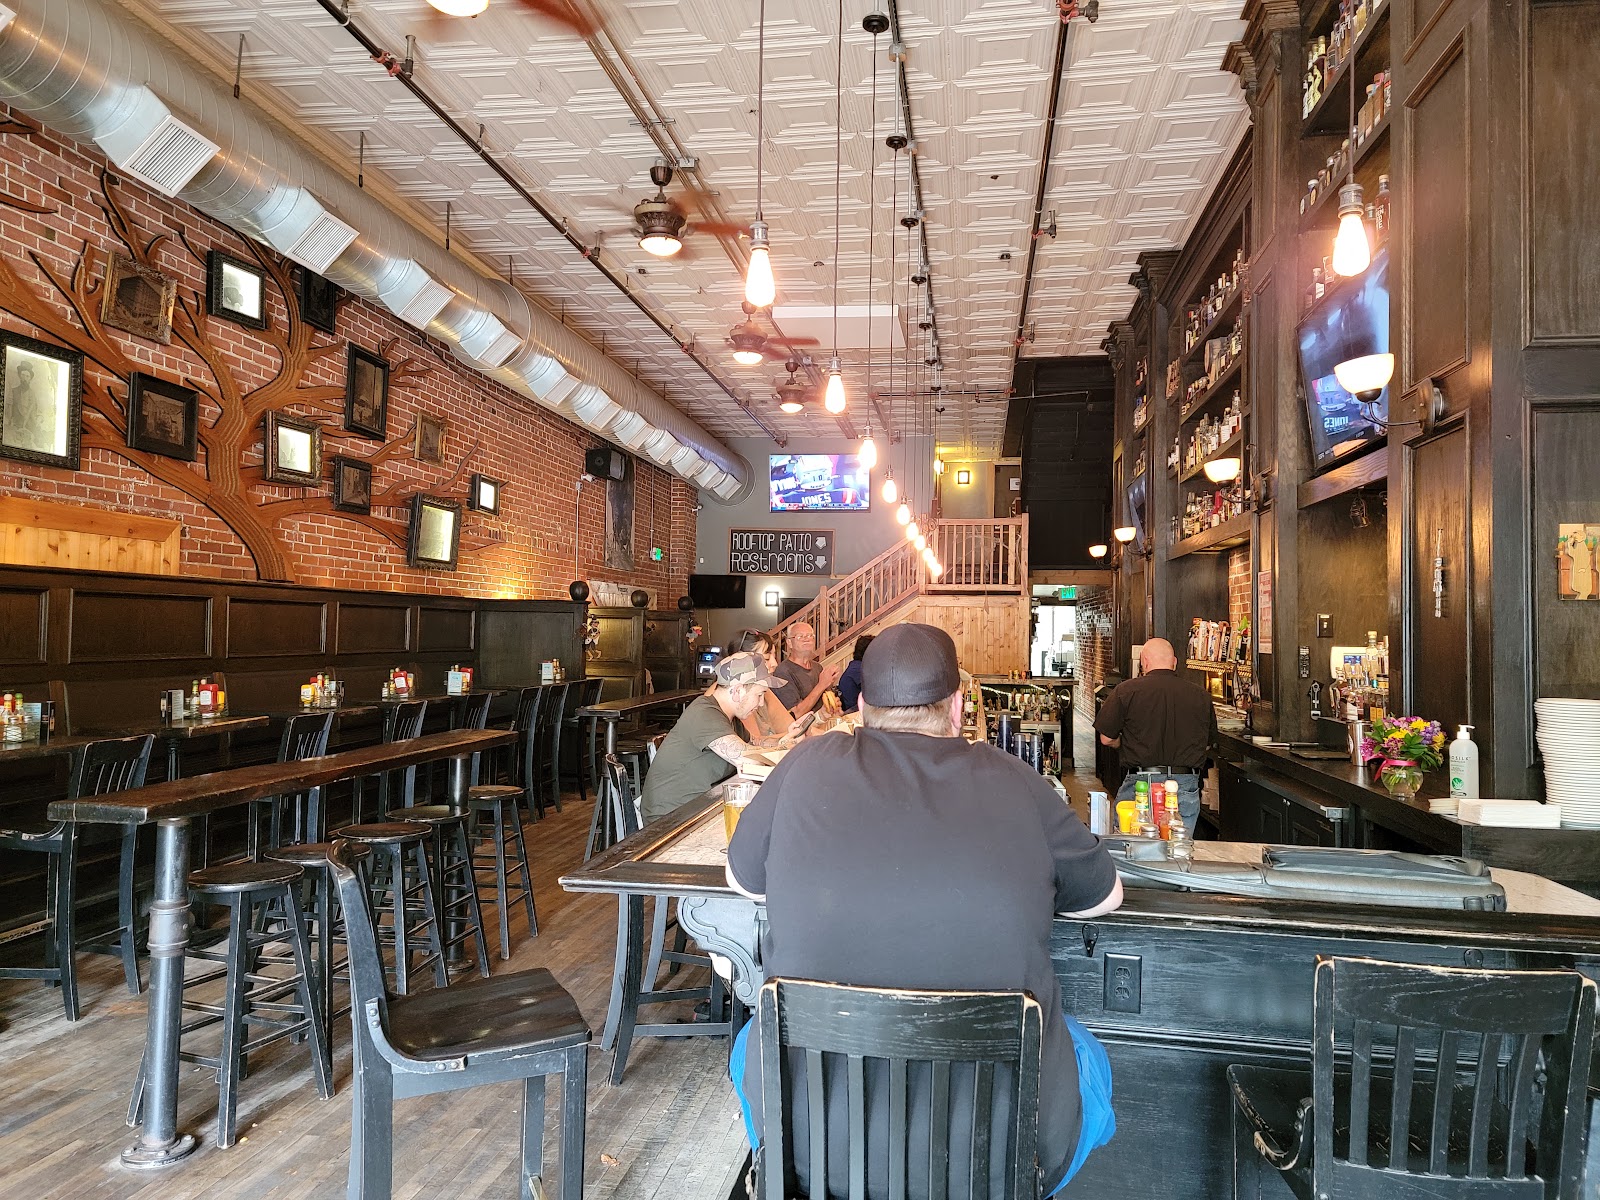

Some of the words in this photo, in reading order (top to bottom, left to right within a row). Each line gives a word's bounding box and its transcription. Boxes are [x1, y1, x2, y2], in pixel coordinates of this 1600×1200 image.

[801, 492, 832, 505] JONES
[732, 533, 775, 551] ROOFTOP
[779, 533, 812, 551] PATIO
[1061, 587, 1076, 599] EXIT
